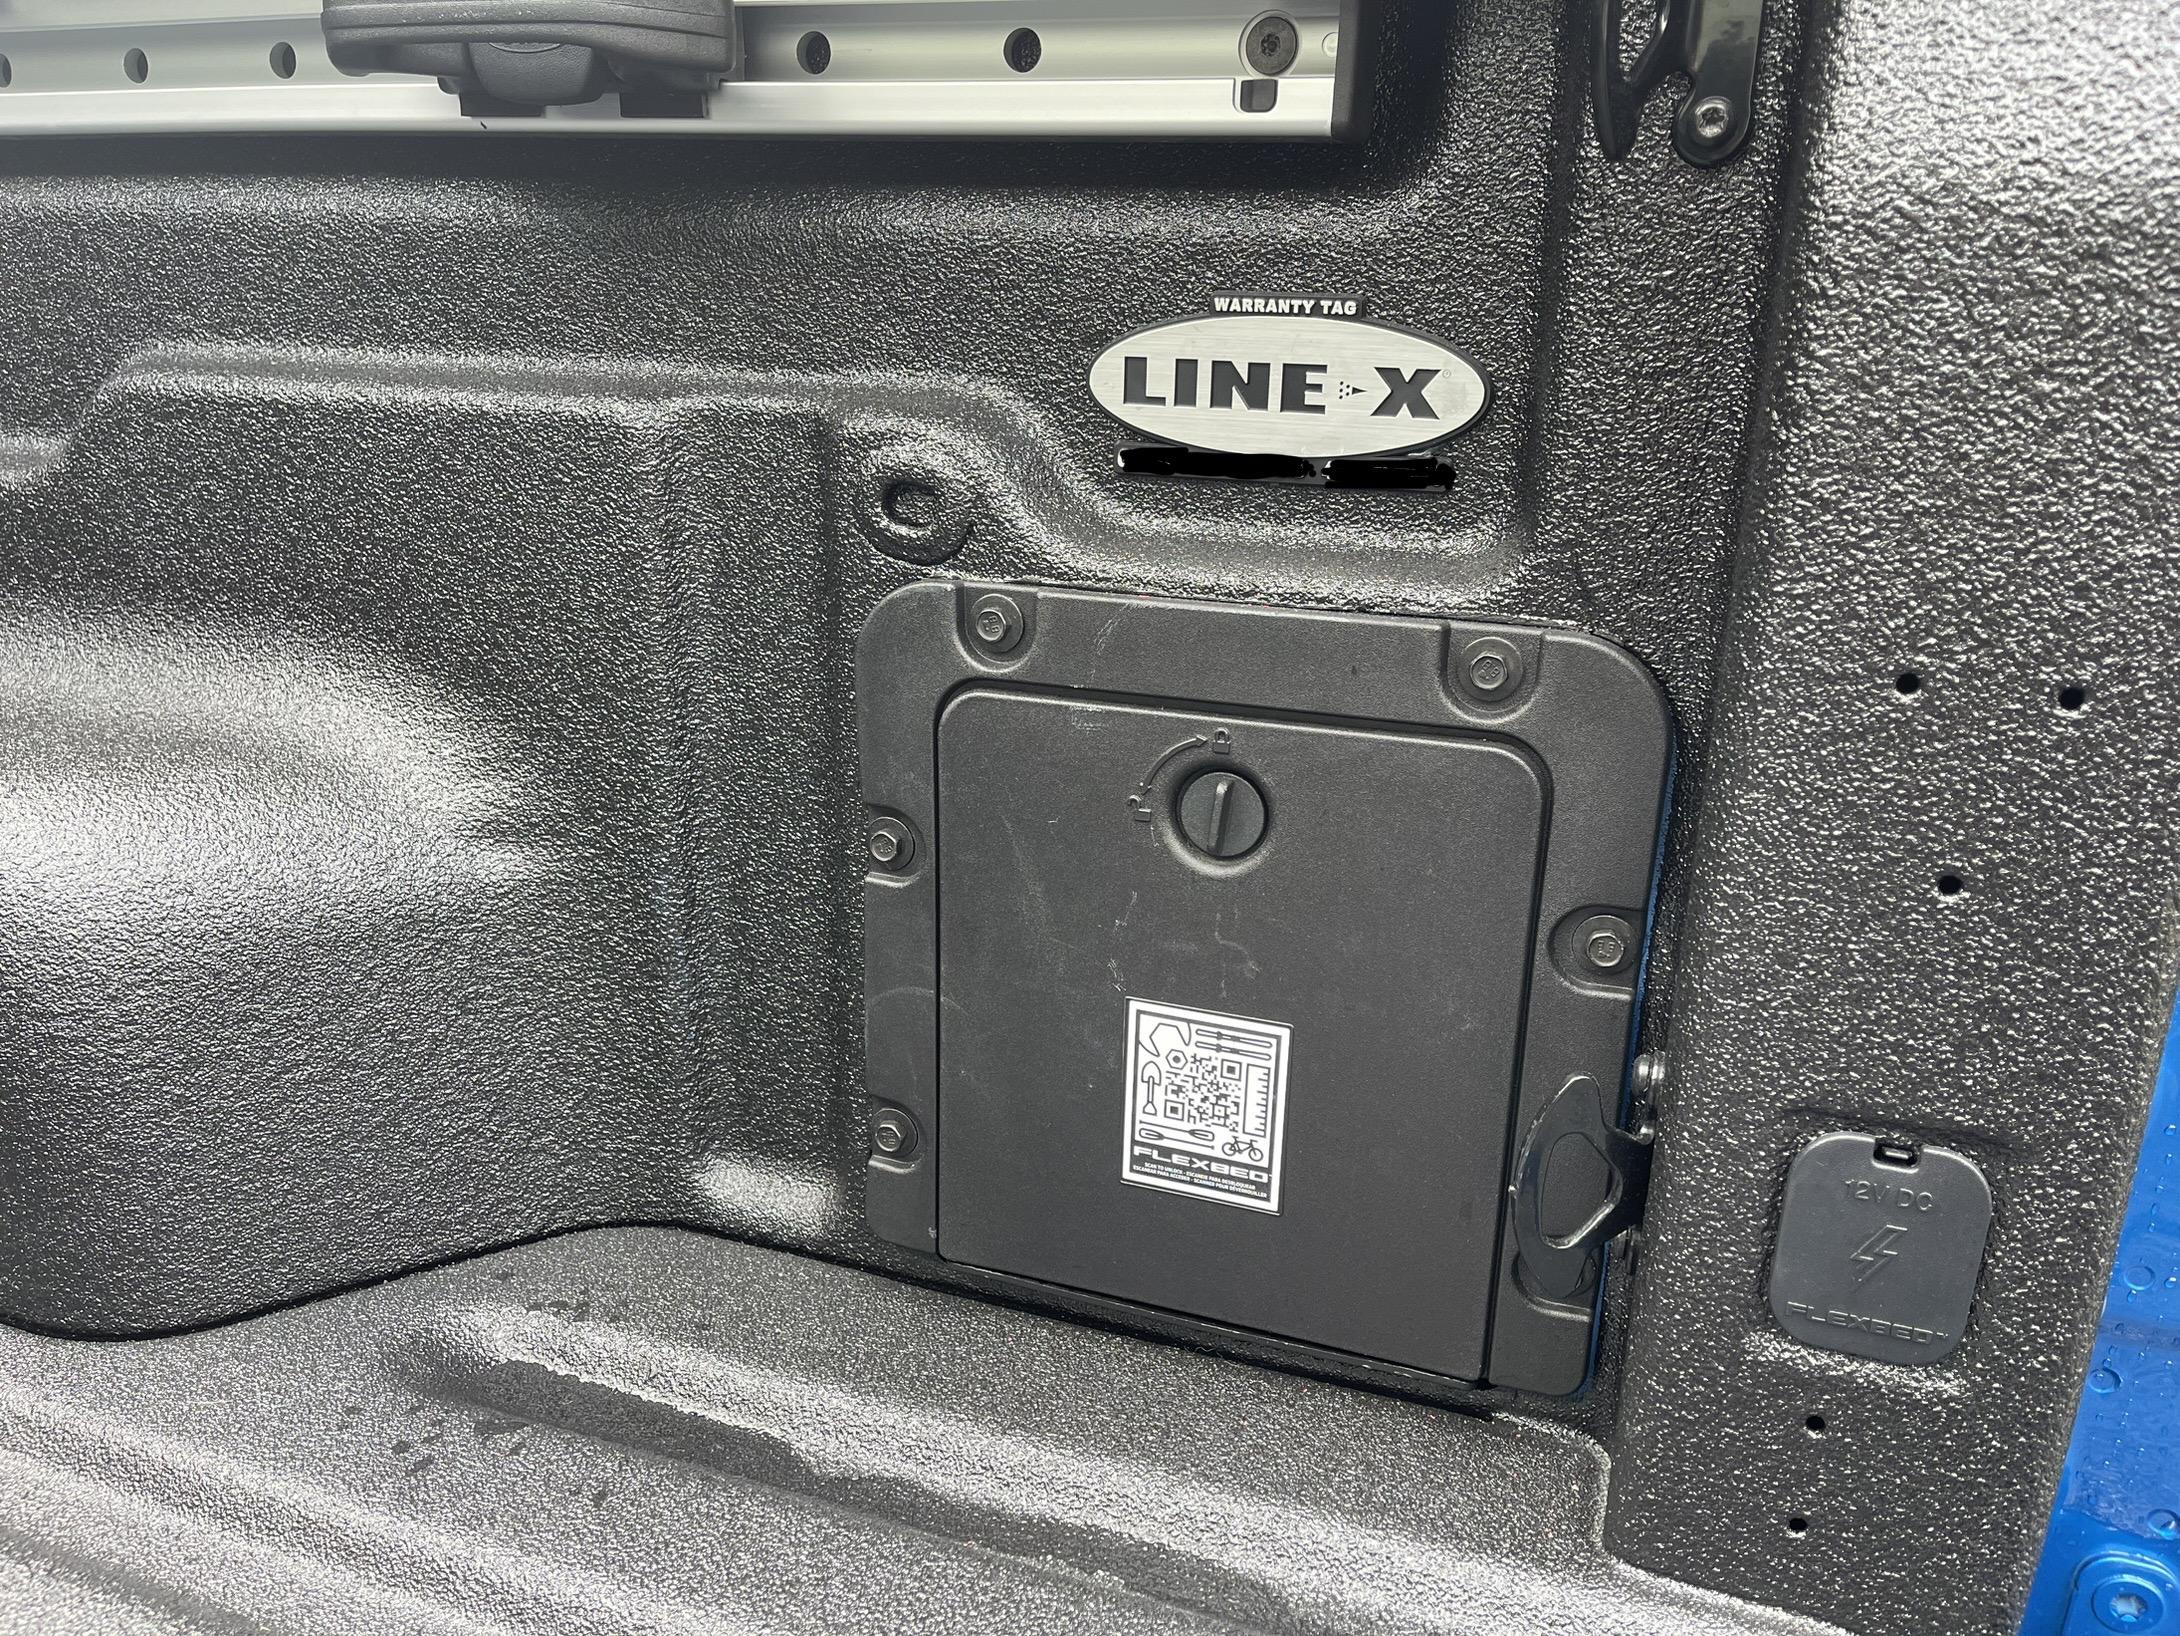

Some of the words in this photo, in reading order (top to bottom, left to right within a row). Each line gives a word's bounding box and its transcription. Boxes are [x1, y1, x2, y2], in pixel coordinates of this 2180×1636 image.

[1213, 298, 1313, 314] WARRANTY
[1320, 300, 1357, 316] TAG
[1133, 1145, 1269, 1184] FLEXBED
[1845, 1179, 1890, 1203] 12V
[1897, 1187, 1935, 1212] DC
[1785, 1301, 1934, 1346] FLEXBED
